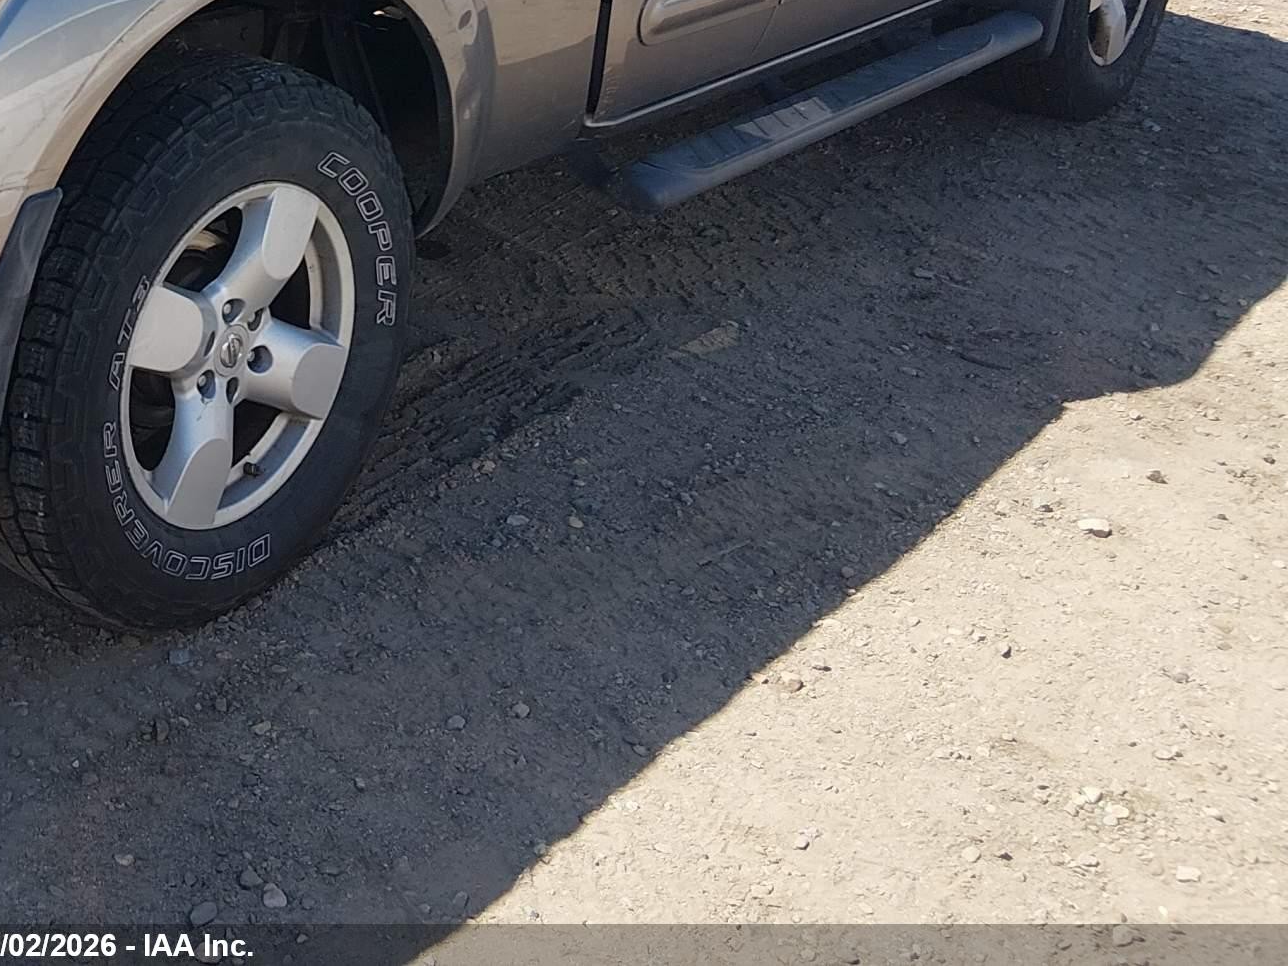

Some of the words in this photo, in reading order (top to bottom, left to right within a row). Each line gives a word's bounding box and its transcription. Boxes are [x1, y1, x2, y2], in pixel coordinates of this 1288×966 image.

[316, 151, 399, 327] COOPER
[108, 274, 151, 391] AT3
[103, 420, 272, 581] DISCOVERER
